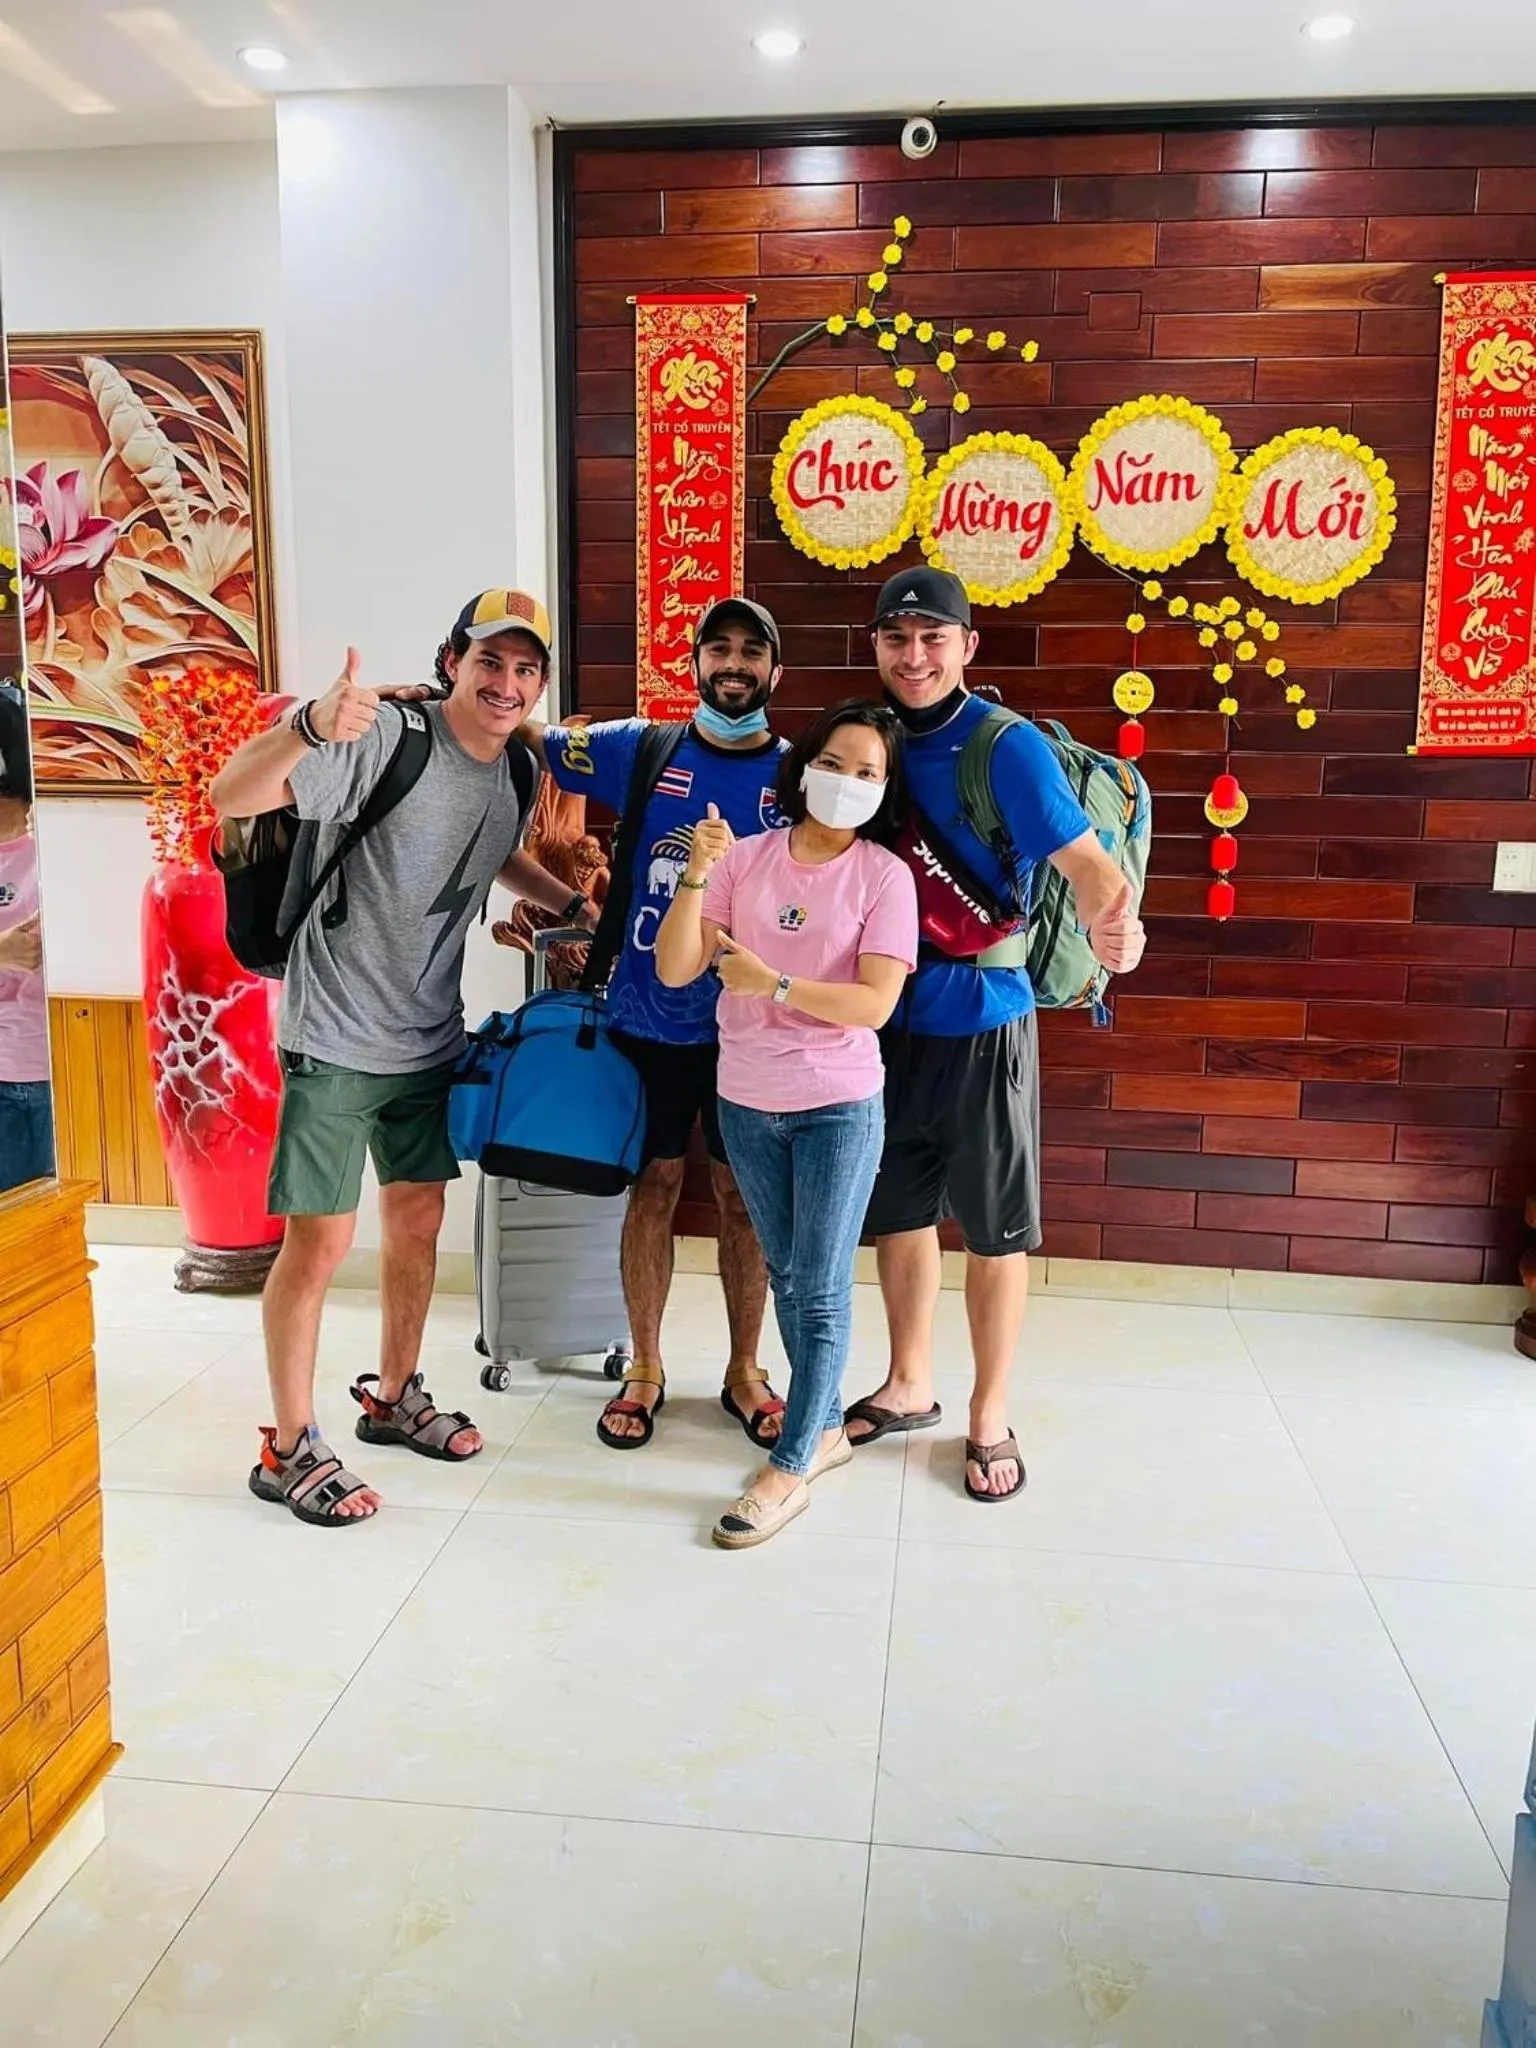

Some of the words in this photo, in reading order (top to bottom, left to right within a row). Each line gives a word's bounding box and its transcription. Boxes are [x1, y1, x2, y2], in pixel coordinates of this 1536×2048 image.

[787, 440, 898, 510] Chúc
[933, 481, 1054, 560] Mừng
[1089, 451, 1204, 511] Năm
[1243, 478, 1369, 541] Mới
